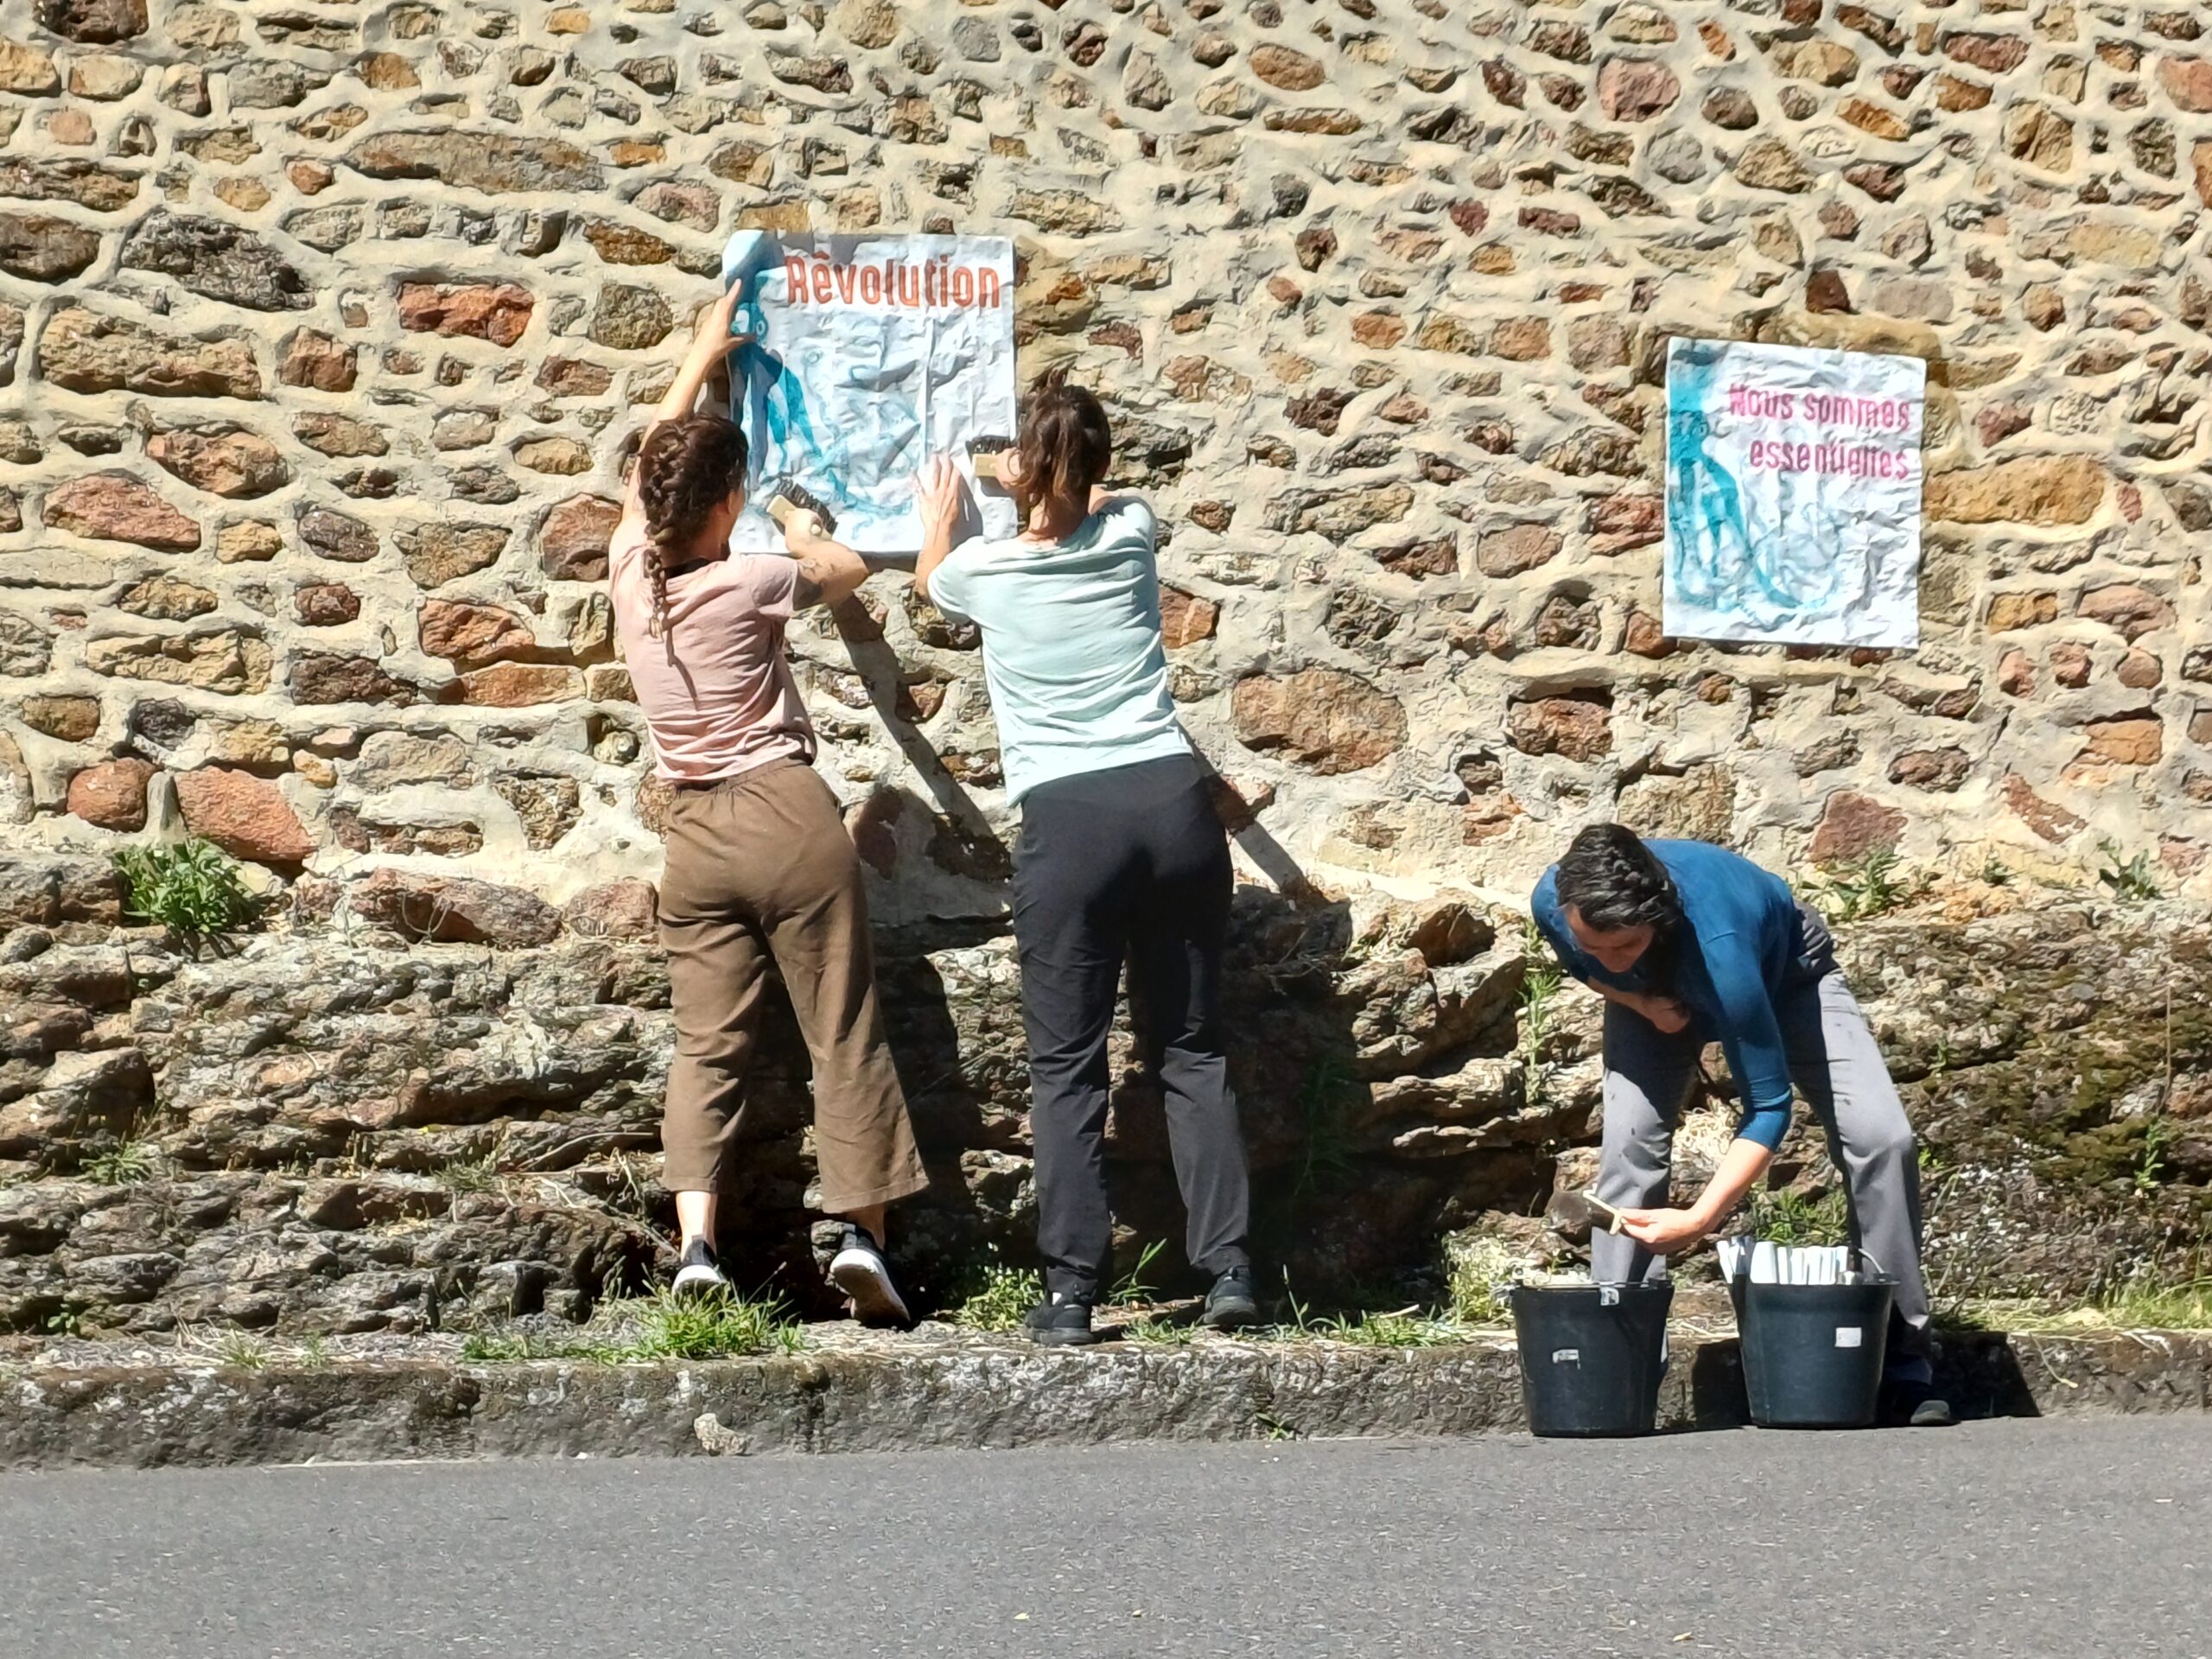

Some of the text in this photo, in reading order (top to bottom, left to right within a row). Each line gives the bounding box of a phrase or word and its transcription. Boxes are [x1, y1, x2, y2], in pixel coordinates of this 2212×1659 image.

[1728, 383, 1910, 431] Nous sommes
[1749, 438, 1910, 480] essentielles
